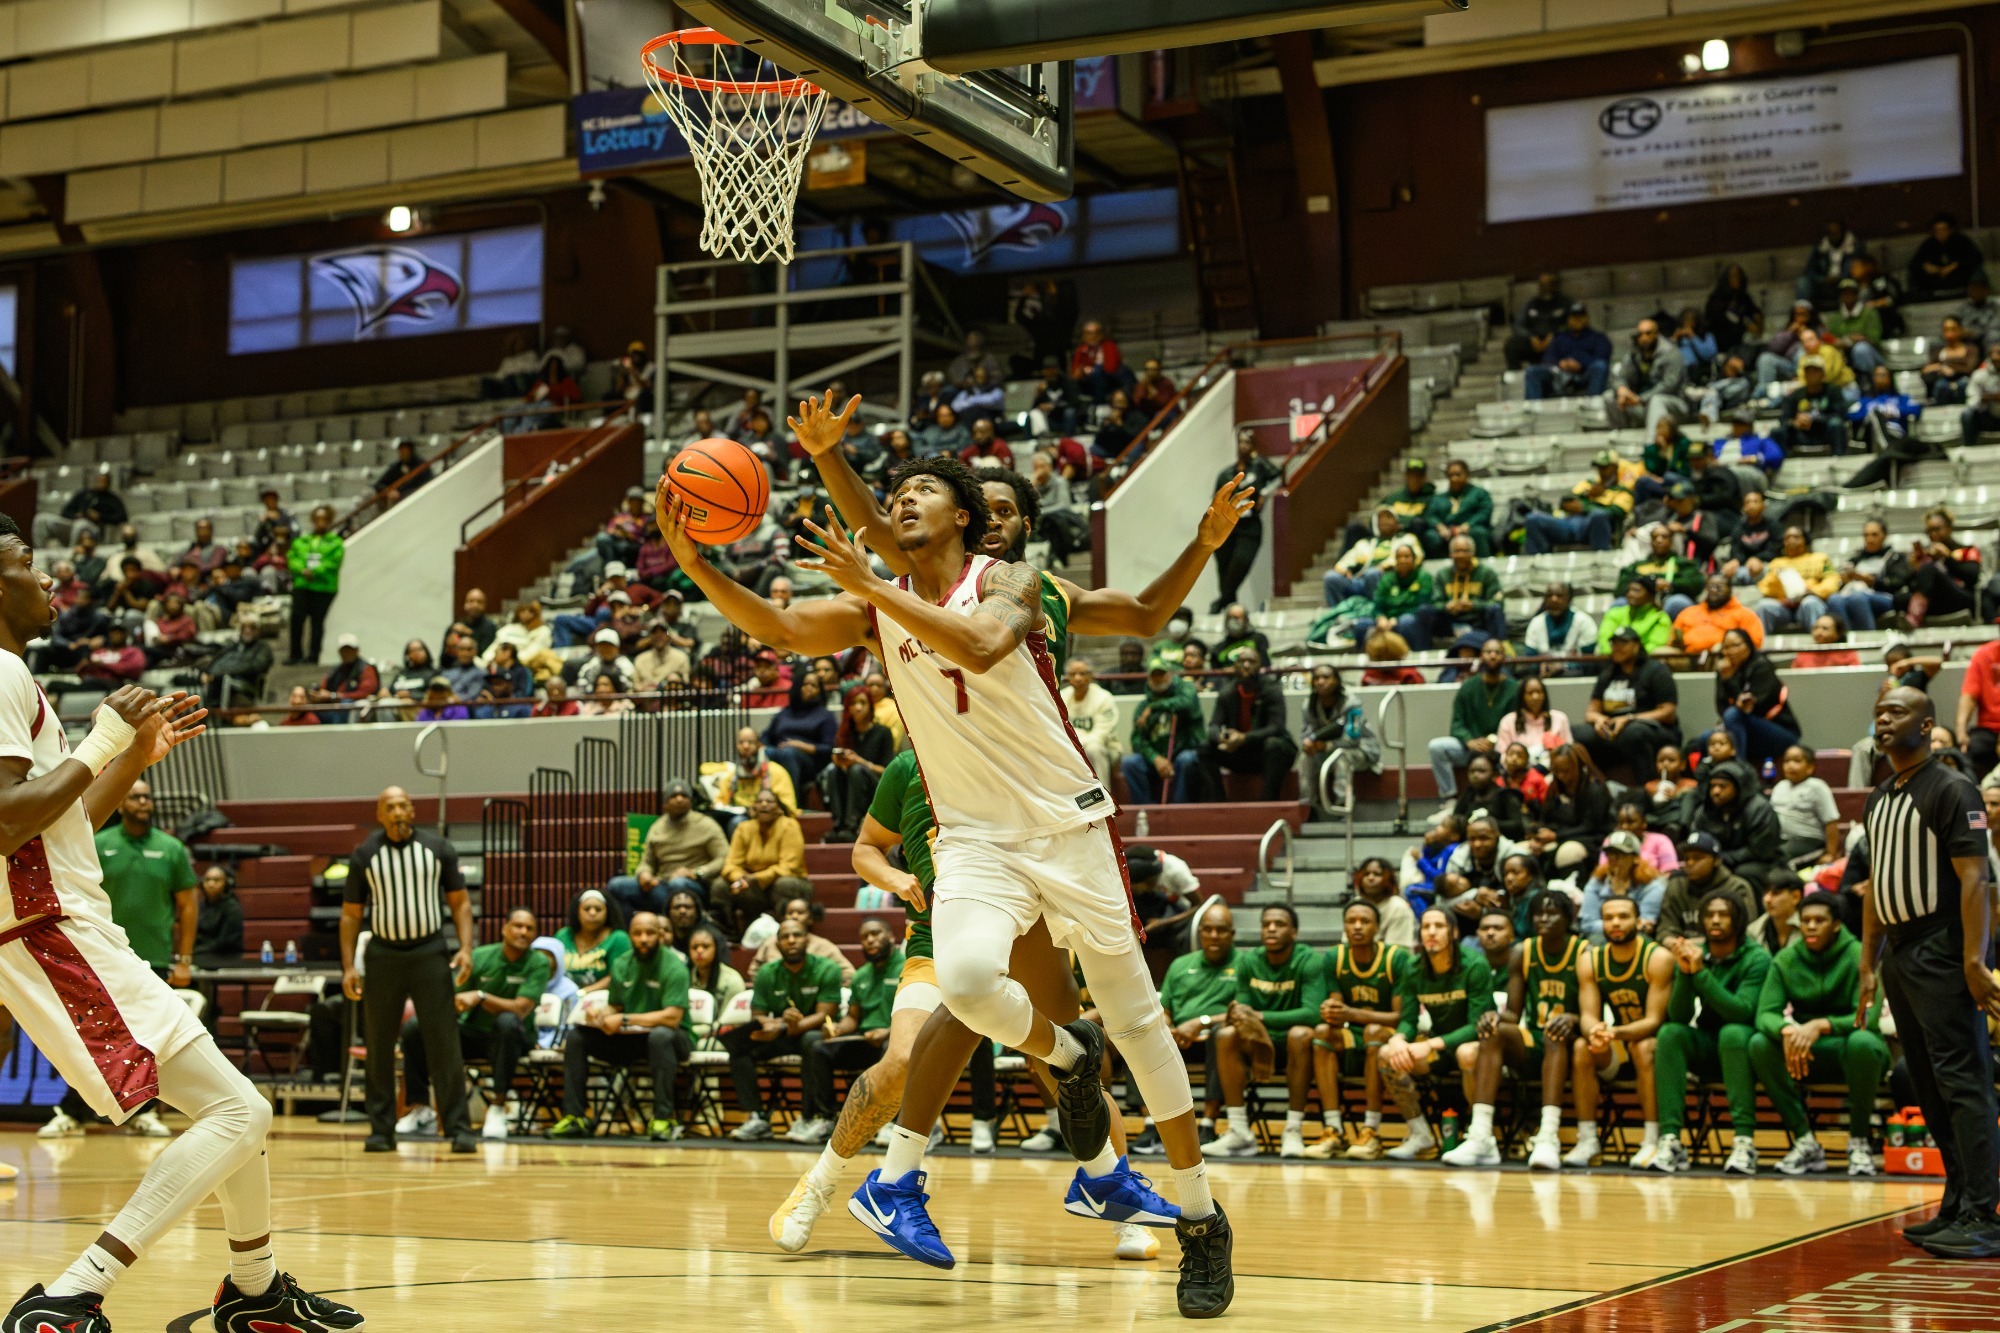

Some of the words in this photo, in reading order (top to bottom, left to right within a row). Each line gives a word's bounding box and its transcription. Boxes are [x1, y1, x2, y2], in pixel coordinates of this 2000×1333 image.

[582, 125, 669, 156] Lottery
[938, 667, 970, 715] 7
[1905, 1151, 1924, 1171] G
